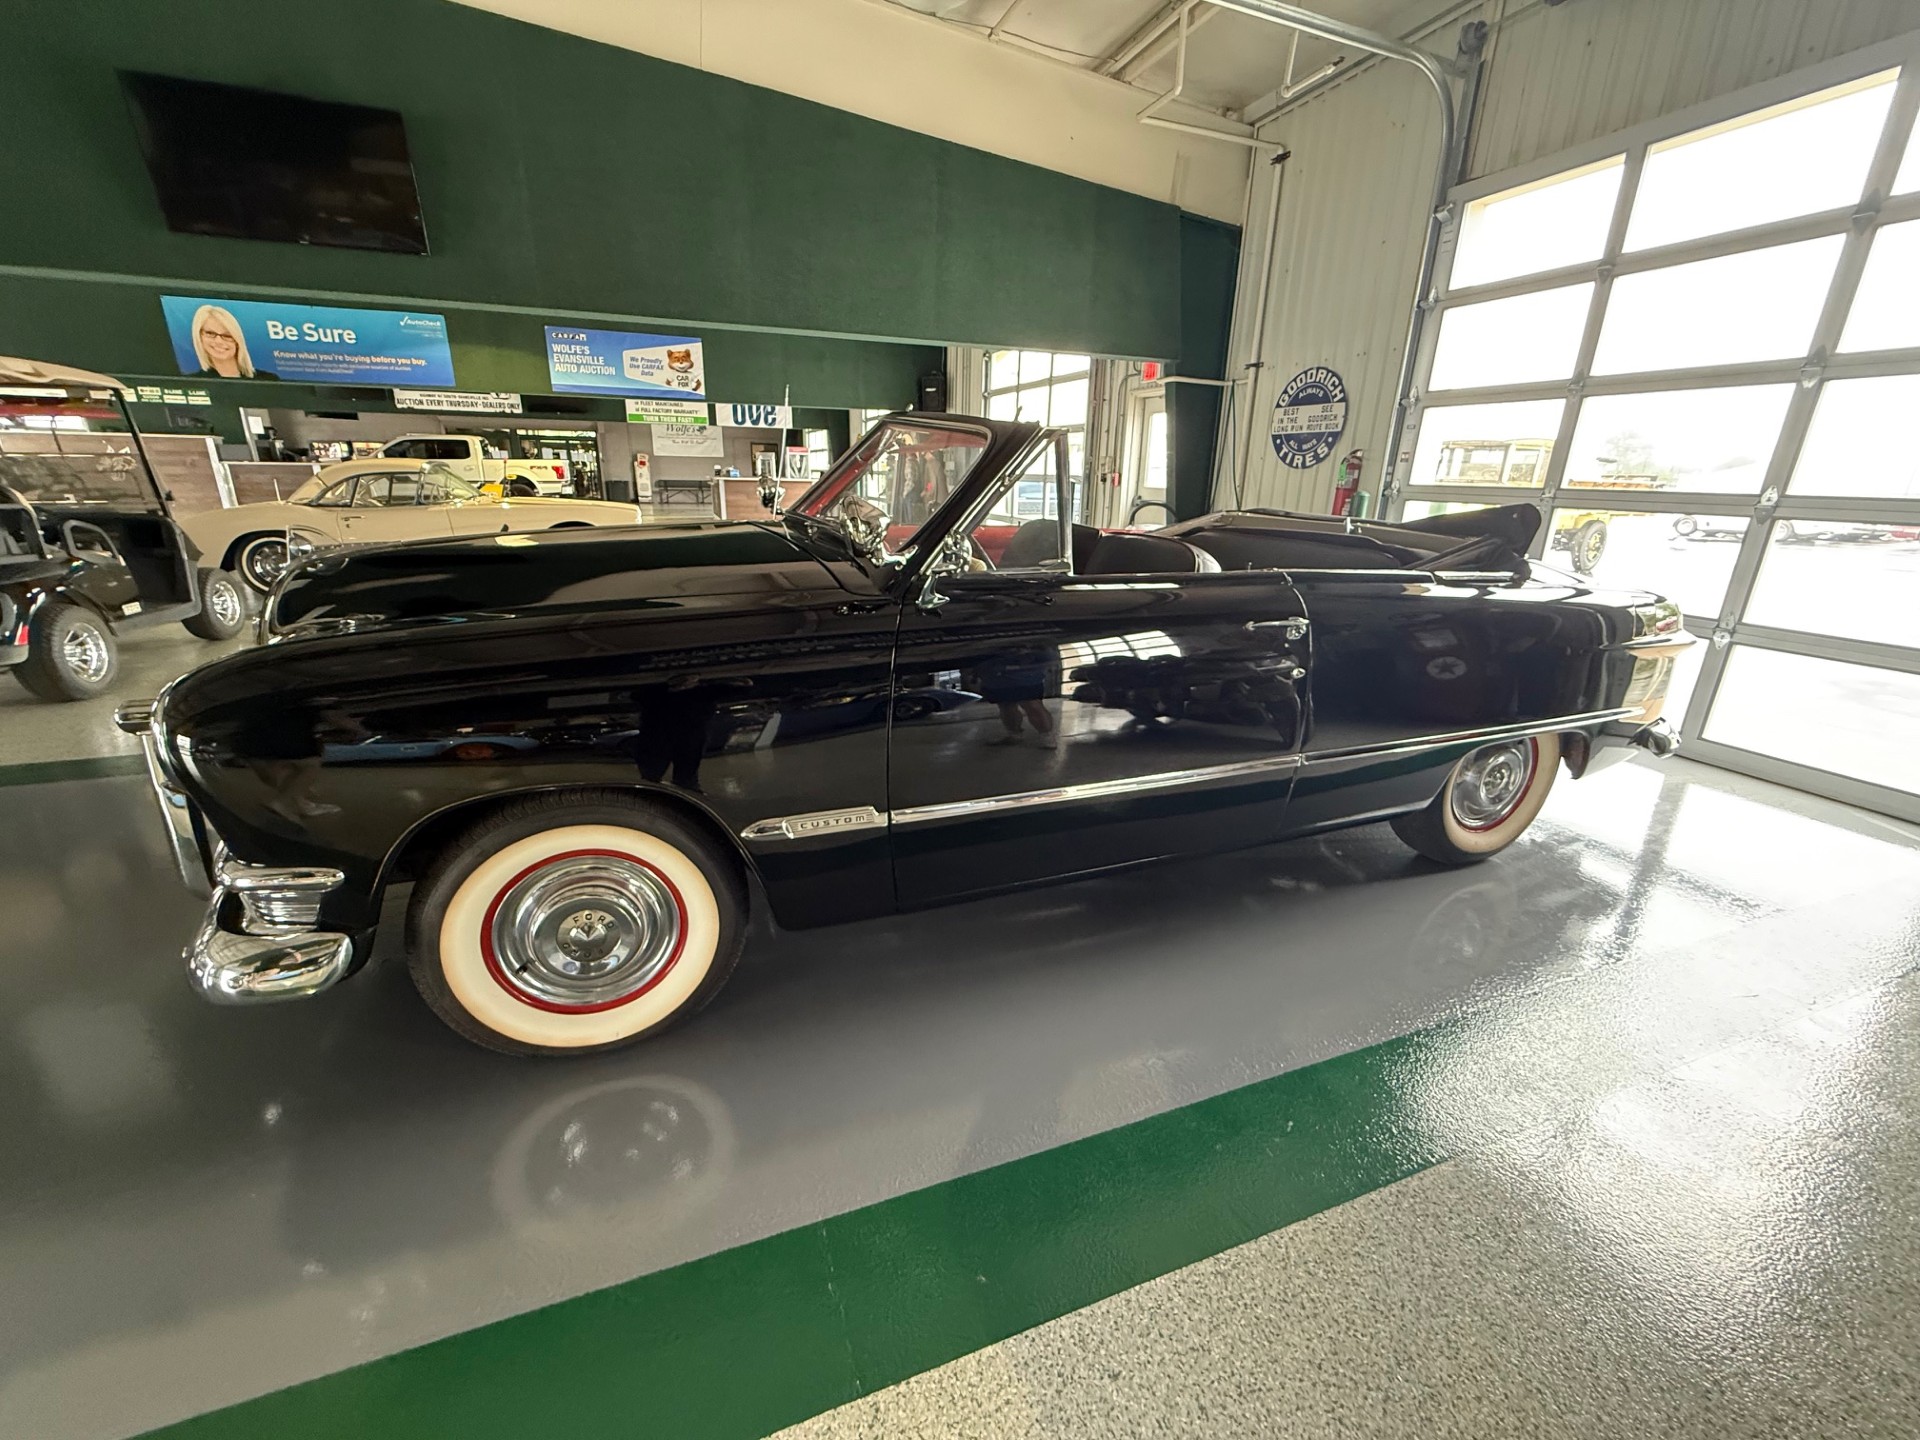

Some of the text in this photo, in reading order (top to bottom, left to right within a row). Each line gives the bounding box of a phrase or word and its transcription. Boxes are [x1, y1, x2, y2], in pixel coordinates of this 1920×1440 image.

[266, 320, 357, 344] Be Sure
[551, 332, 587, 341] CARFAX
[551, 343, 590, 355] WOLFE'S
[273, 350, 297, 359] Know
[297, 351, 318, 360] what
[319, 353, 343, 362] you're
[344, 354, 370, 364] buying
[371, 355, 396, 364] before
[397, 357, 411, 365] you
[411, 357, 428, 367] buy.
[553, 353, 605, 365] EVANSVILLE
[554, 363, 616, 376] AUTO AUCTION
[641, 363, 664, 371] CARFAX
[1278, 368, 1344, 407] GOODRICH
[1298, 386, 1324, 399] ALWAYS
[397, 398, 424, 406] AUCTION
[425, 399, 445, 407] EVERY
[507, 402, 520, 410] ONLY
[1321, 405, 1334, 413] SEE
[1283, 408, 1300, 416] BEST
[1286, 416, 1298, 424] THE
[1307, 414, 1338, 423] GOODRICH
[1273, 424, 1304, 433] LONG RUN
[1306, 422, 1340, 431] ROUTE BOOK
[1288, 440, 1298, 450] ALL
[1279, 442, 1329, 469] TIRES
[800, 816, 865, 829] CUSTOM
[572, 913, 615, 928] FORD
